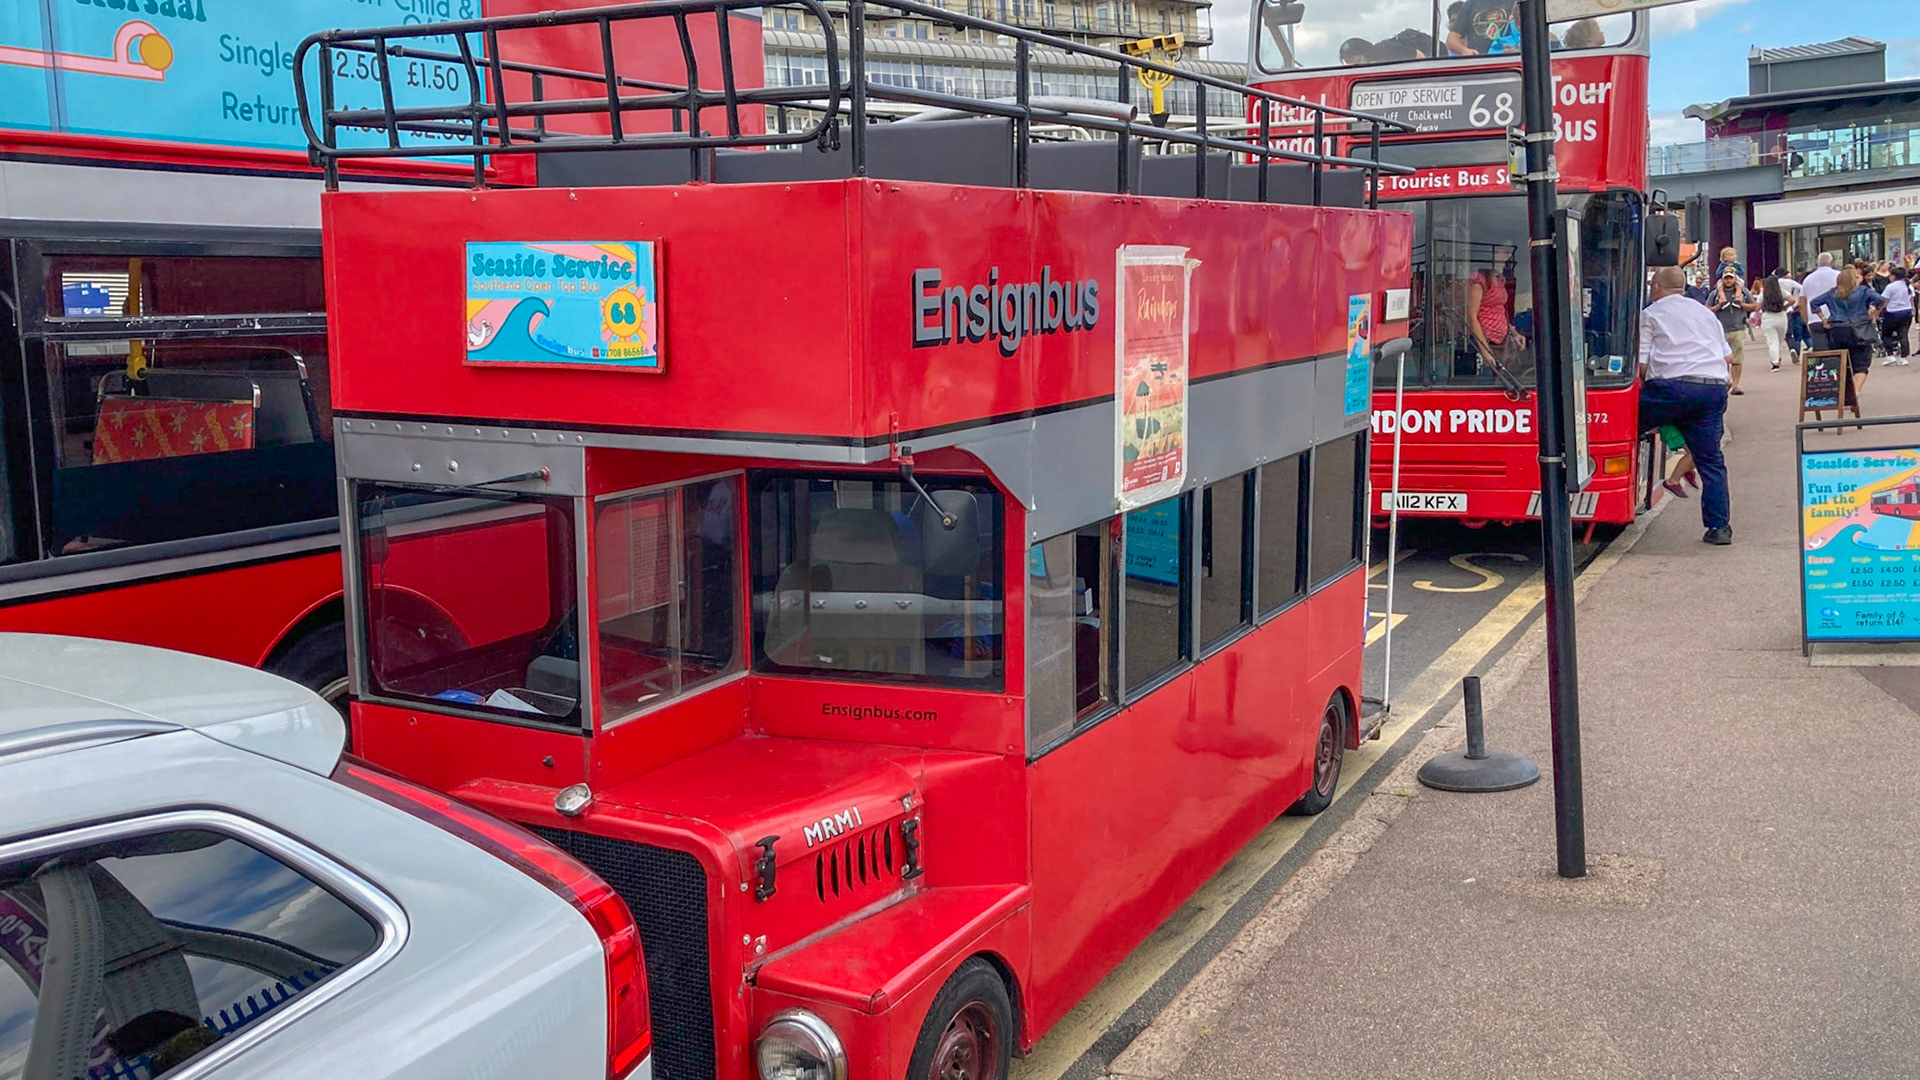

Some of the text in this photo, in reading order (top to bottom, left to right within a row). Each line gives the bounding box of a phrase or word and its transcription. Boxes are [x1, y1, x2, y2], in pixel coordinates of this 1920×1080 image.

[219, 34, 459, 92] Single 2.50 £1.50
[1551, 75, 1612, 107] Tour
[1355, 88, 1515, 128] OPEN TOP SERVICE 68
[1408, 109, 1453, 121] Chalkwell
[1415, 123, 1439, 132] dway
[1552, 112, 1597, 143] Bus
[1389, 172, 1450, 190] Tourist
[1457, 170, 1489, 187] Bus
[1825, 195, 1919, 214] SOUTHEND PIE
[472, 253, 632, 280] Seaside Service
[472, 279, 599, 294] Southend Open Top Bus
[611, 302, 636, 325] 68
[912, 265, 1099, 358] Ensignbus
[600, 348, 622, 357] 01708
[1370, 409, 1442, 434] NDON
[1449, 409, 1531, 433] PRIDE
[1806, 455, 1917, 470] Seaside Service
[1807, 482, 1858, 494] Fun for
[1424, 496, 1458, 509] KFX
[1810, 494, 1855, 505] all the
[1810, 506, 1860, 519] family!
[1856, 611, 1883, 620] Family
[1886, 611, 1896, 619] of
[822, 702, 938, 721] Ensignbus.com
